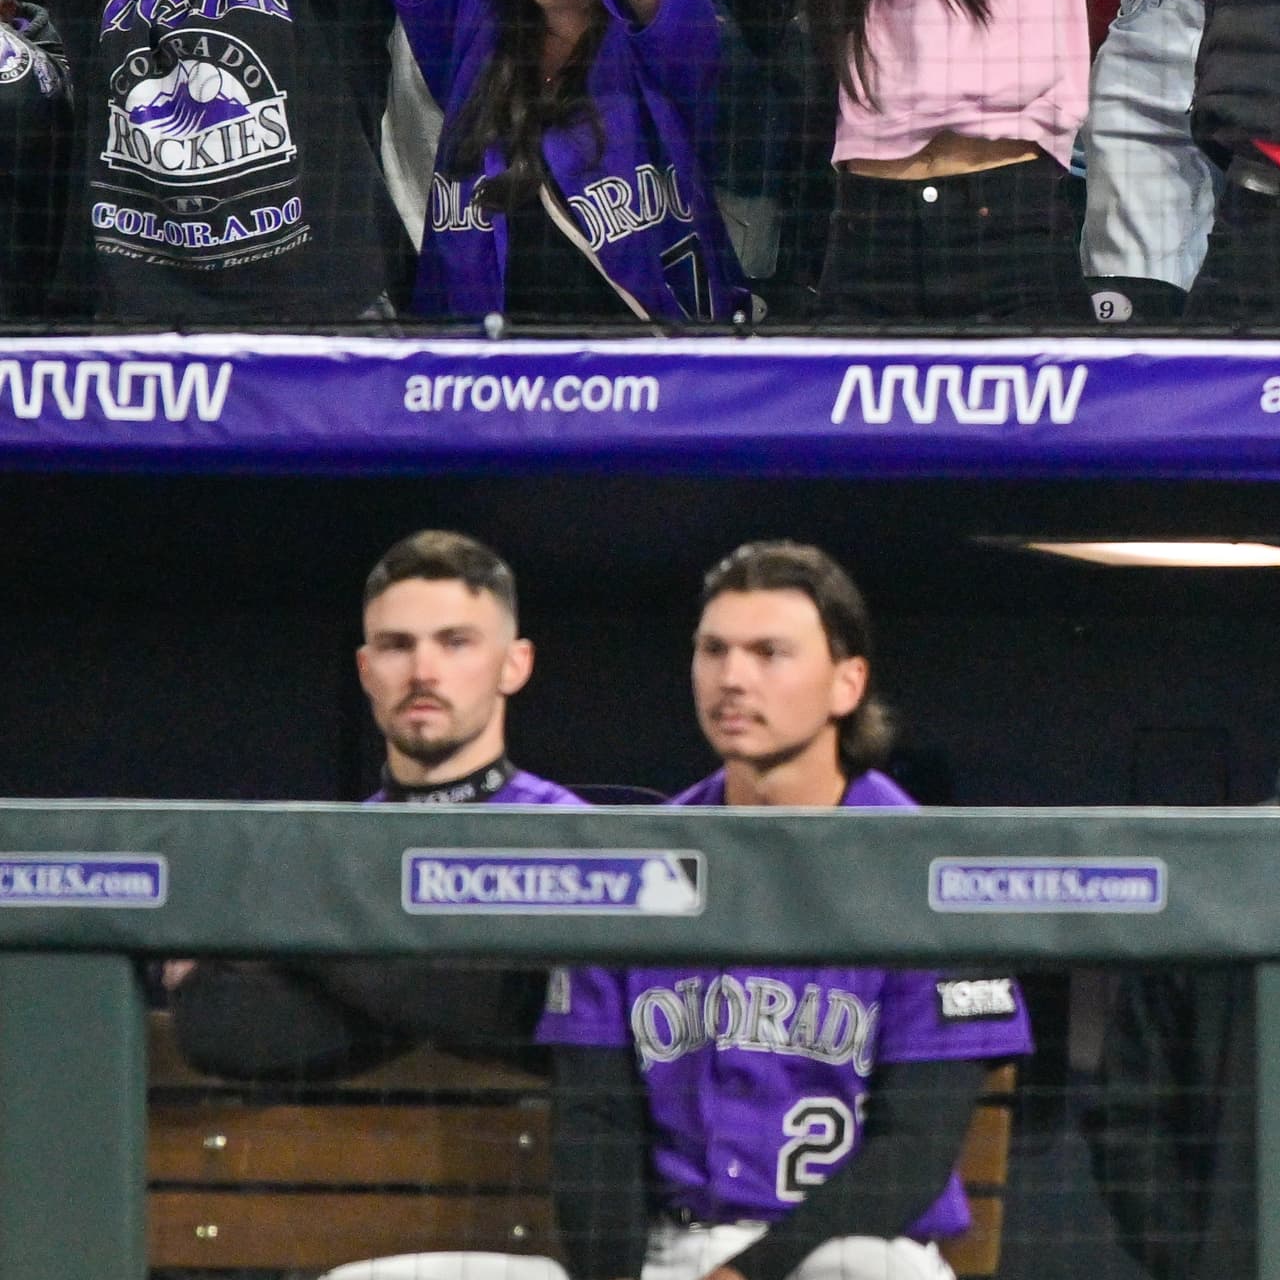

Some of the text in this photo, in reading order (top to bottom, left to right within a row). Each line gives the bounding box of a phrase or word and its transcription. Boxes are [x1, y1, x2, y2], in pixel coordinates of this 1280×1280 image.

[112, 104, 288, 170] ROCKIES
[91, 196, 303, 248] COLORADO
[1100, 300, 1114, 319] 9
[403, 373, 661, 413] arrow.com
[831, 364, 1088, 426] ARROW
[776, 1094, 870, 1202] 2
